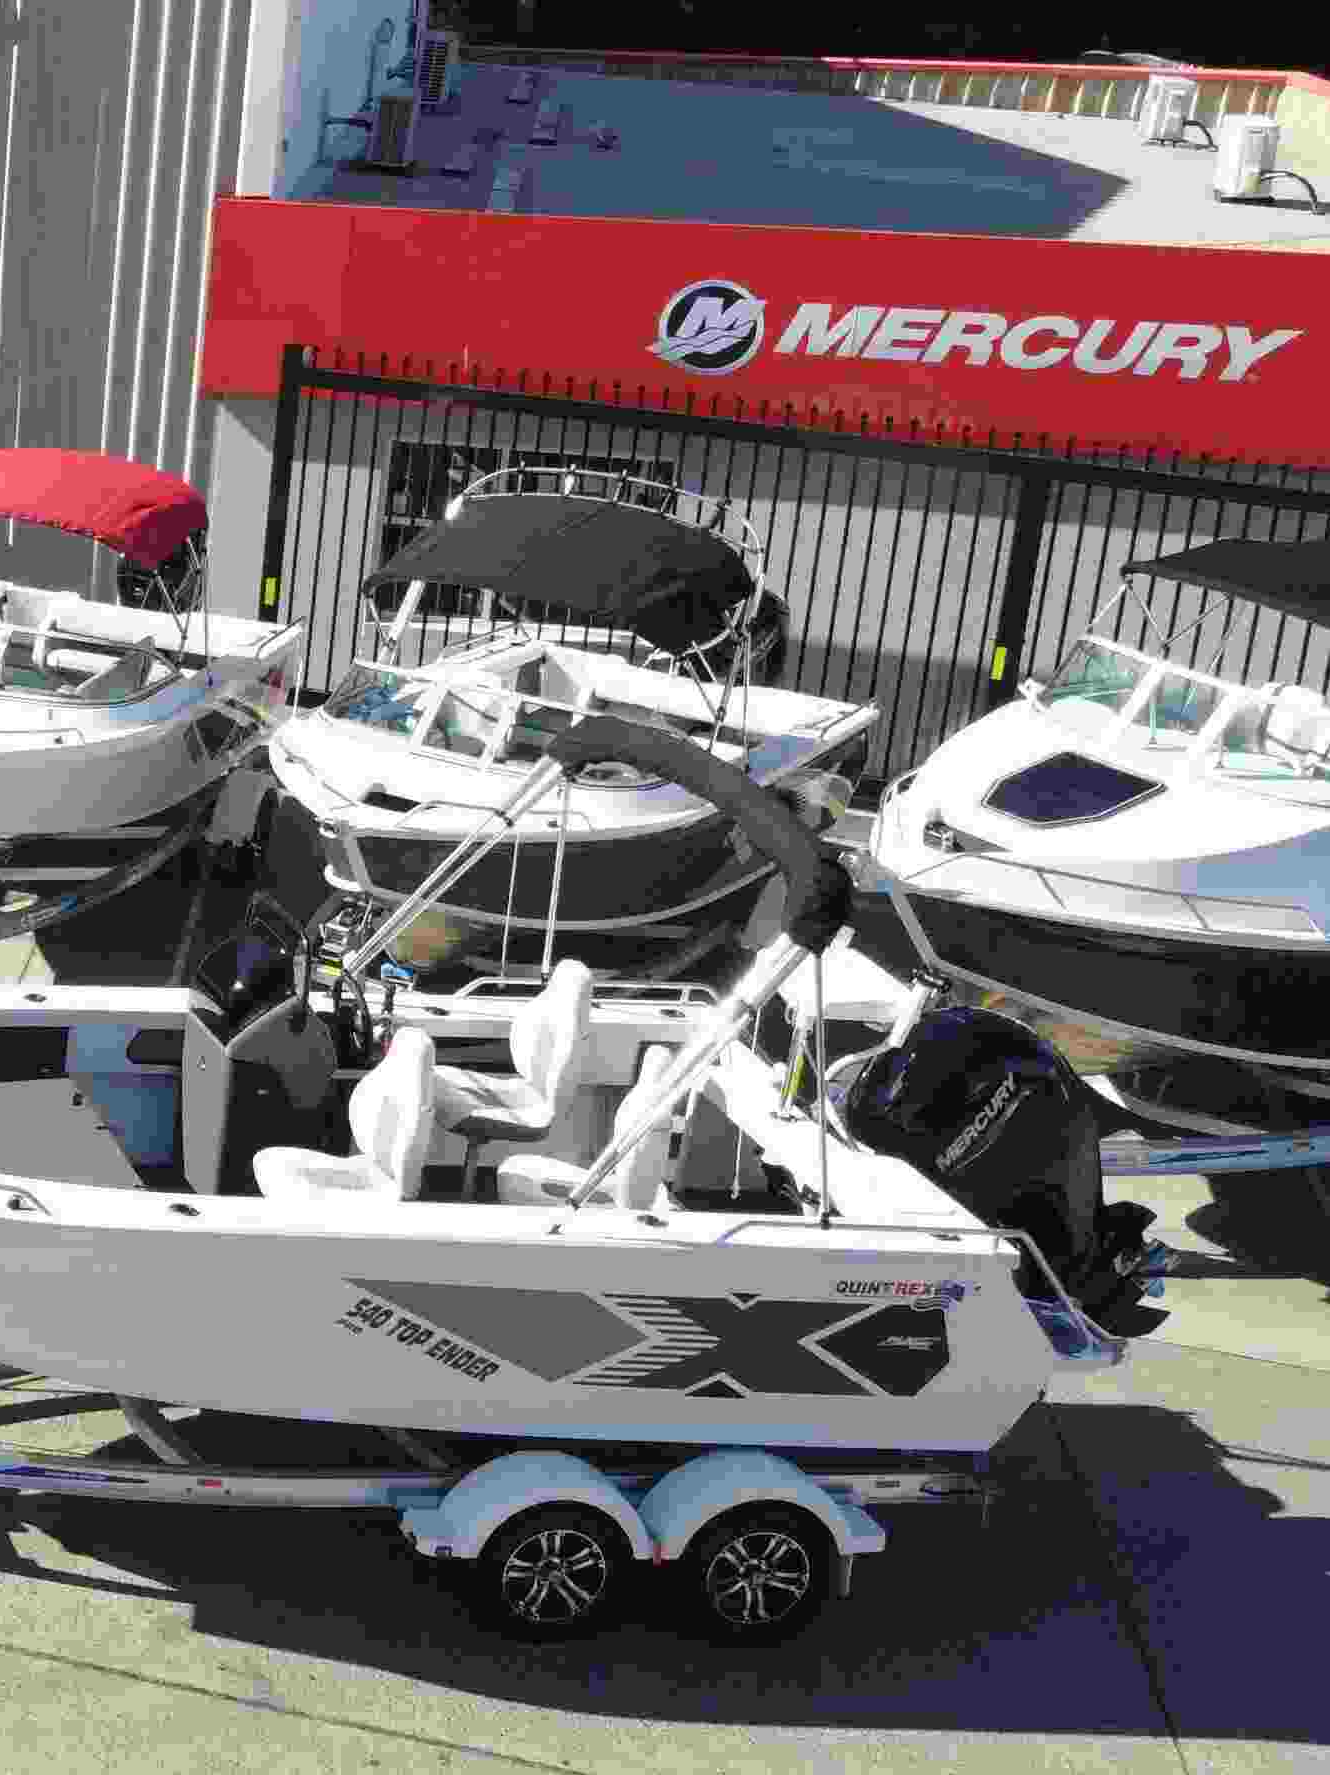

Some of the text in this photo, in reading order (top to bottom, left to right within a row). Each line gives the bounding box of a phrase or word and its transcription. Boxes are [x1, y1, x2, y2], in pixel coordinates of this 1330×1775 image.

[773, 302, 1306, 381] MERCURY
[937, 1071, 1016, 1172] MERCURY
[835, 1279, 935, 1297] QUINTREX
[345, 1297, 394, 1329] 540
[386, 1317, 434, 1345] TOP
[425, 1338, 500, 1383] ENDER
